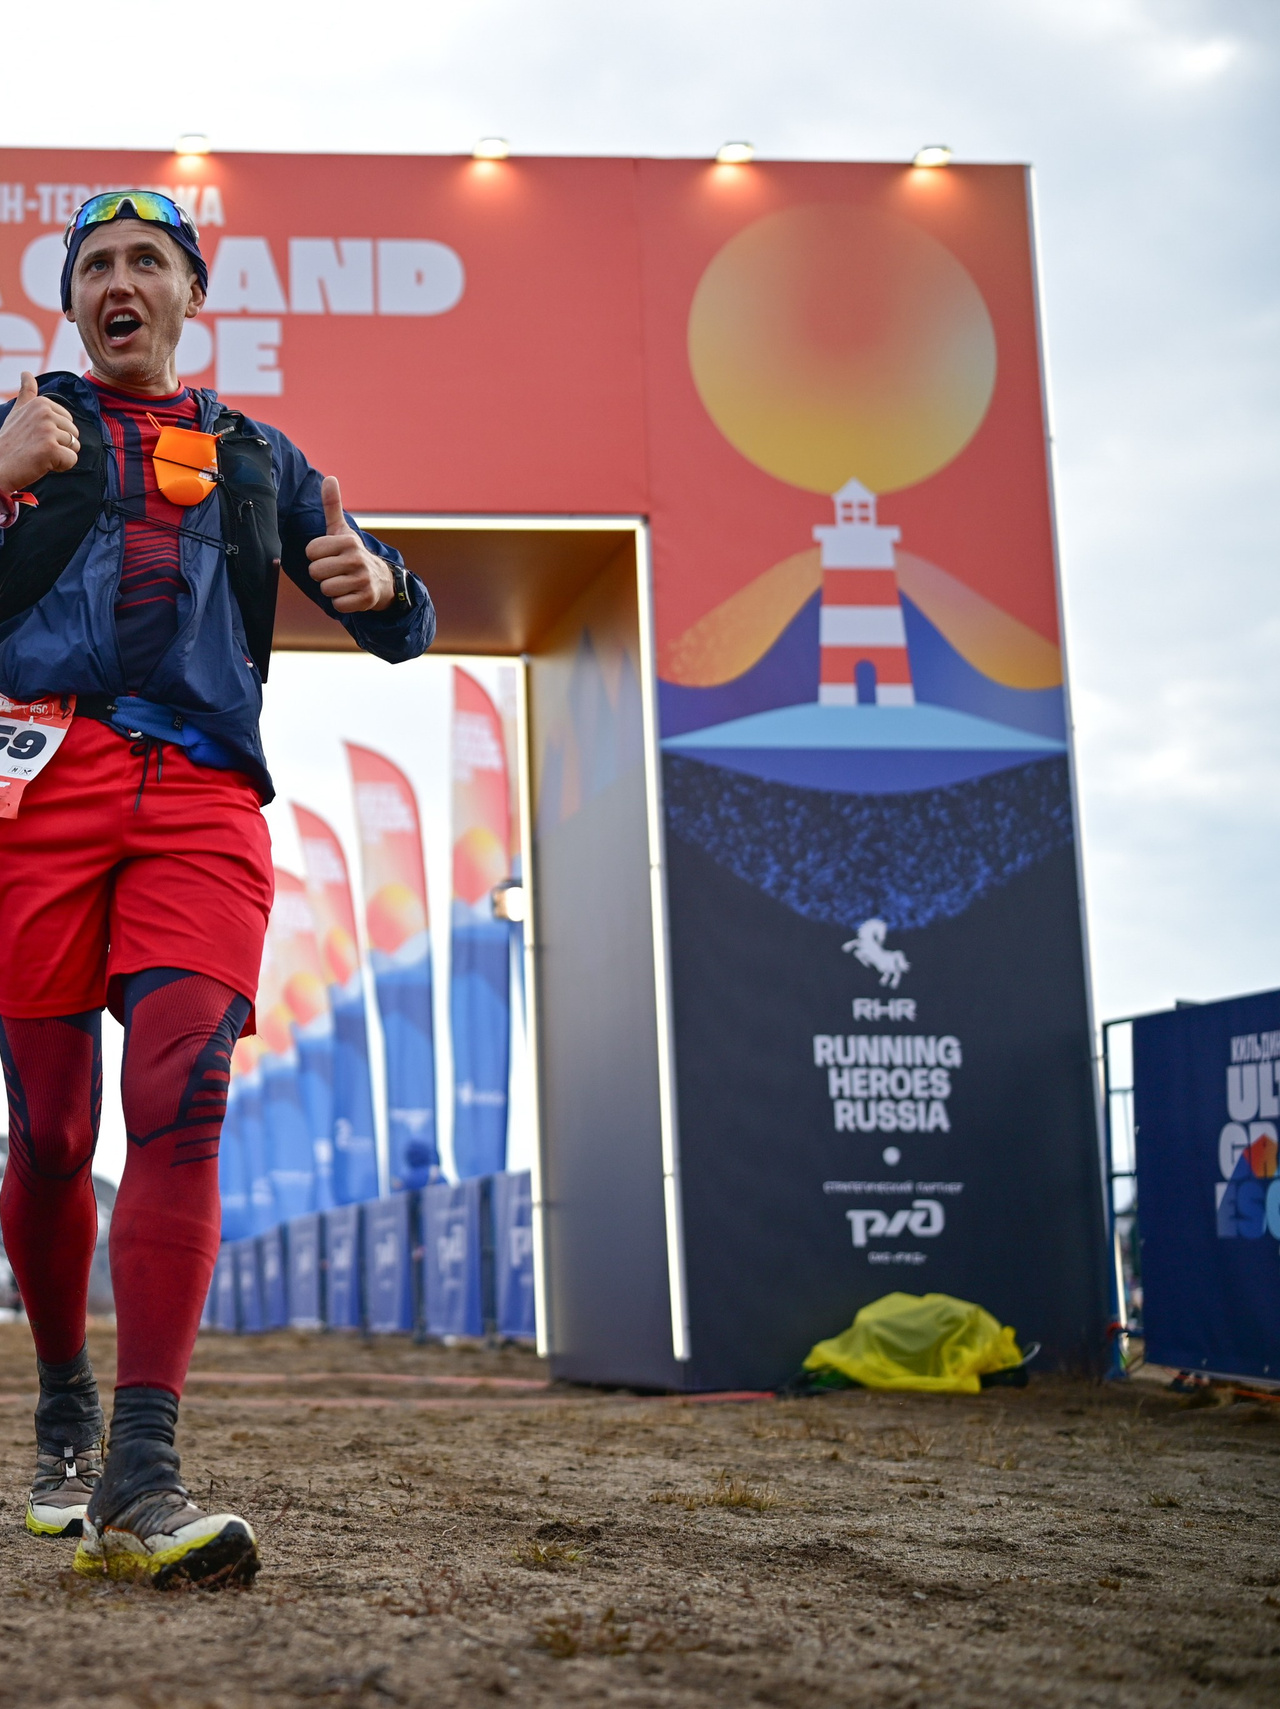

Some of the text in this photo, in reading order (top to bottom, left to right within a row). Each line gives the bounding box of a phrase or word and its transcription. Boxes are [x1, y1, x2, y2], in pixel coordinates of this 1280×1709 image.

[20, 230, 465, 317] GAND
[852, 998, 917, 1021] RHR
[813, 1034, 963, 1068] RUNNING
[828, 1067, 952, 1100] HEROES
[1227, 1061, 1280, 1122] UL
[834, 1100, 951, 1133] RUSSIA
